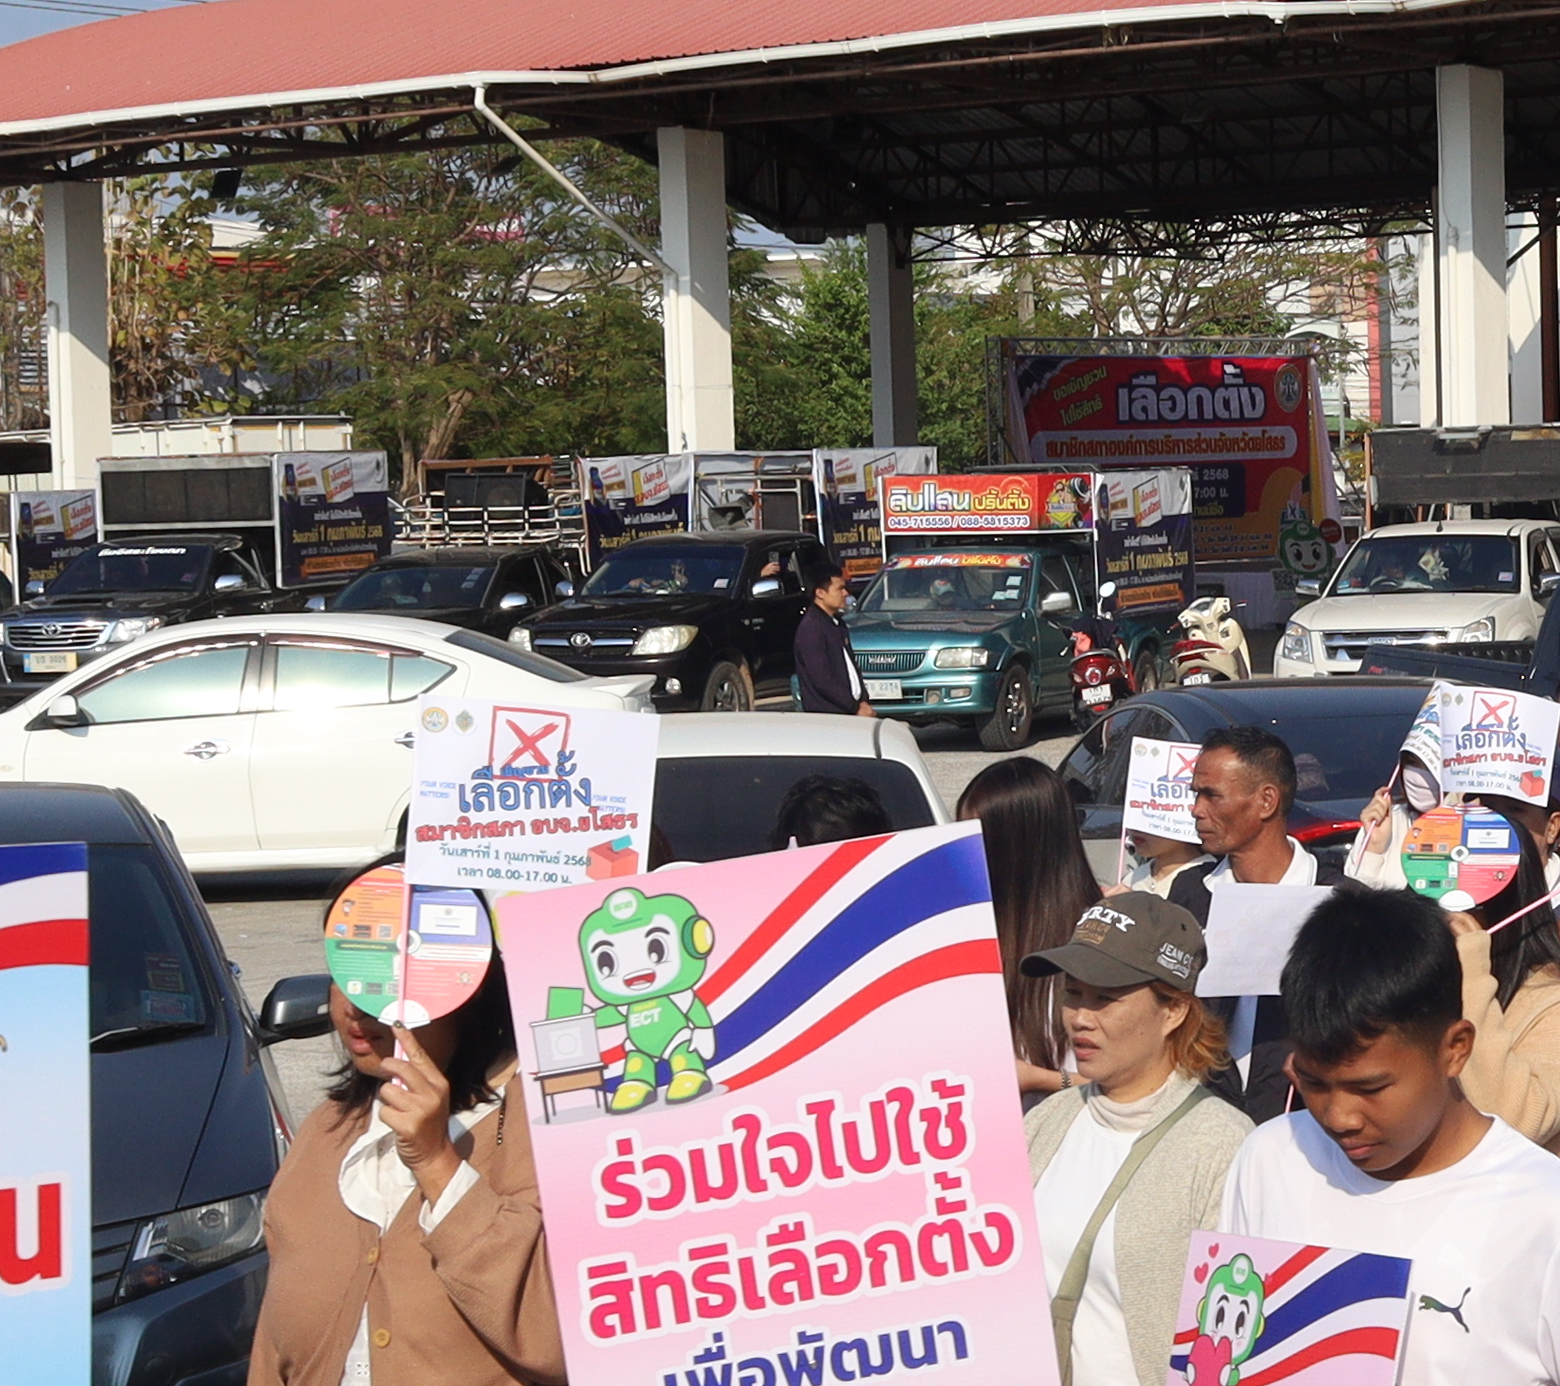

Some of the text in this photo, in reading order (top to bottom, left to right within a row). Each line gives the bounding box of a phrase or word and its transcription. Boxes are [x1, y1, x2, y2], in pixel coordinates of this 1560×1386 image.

[1118, 364, 1265, 420] เลือกตั้ง
[1046, 431, 1286, 459] สมาชิกสภาองค์การบริหารส่วนจังหวัดยโสธร
[1202, 469, 1229, 480] 2568
[1455, 716, 1527, 753] เลือกตั้ง
[458, 750, 593, 813] เลือกตั้ง
[415, 806, 639, 842] สมาชิกสภา อบจ.ยโสธร
[440, 842, 593, 867] วันเสาร์ที่ 1 กุมภาพันธ์ 2568
[458, 866, 572, 884] เวลา 08.00-17.00 น.
[1159, 942, 1184, 963] JEAN
[629, 1007, 662, 1028] ECT
[599, 1079, 969, 1221] ร่วมใจไปใช้
[587, 1169, 1016, 1340] สิทธิเลือกตั้ง
